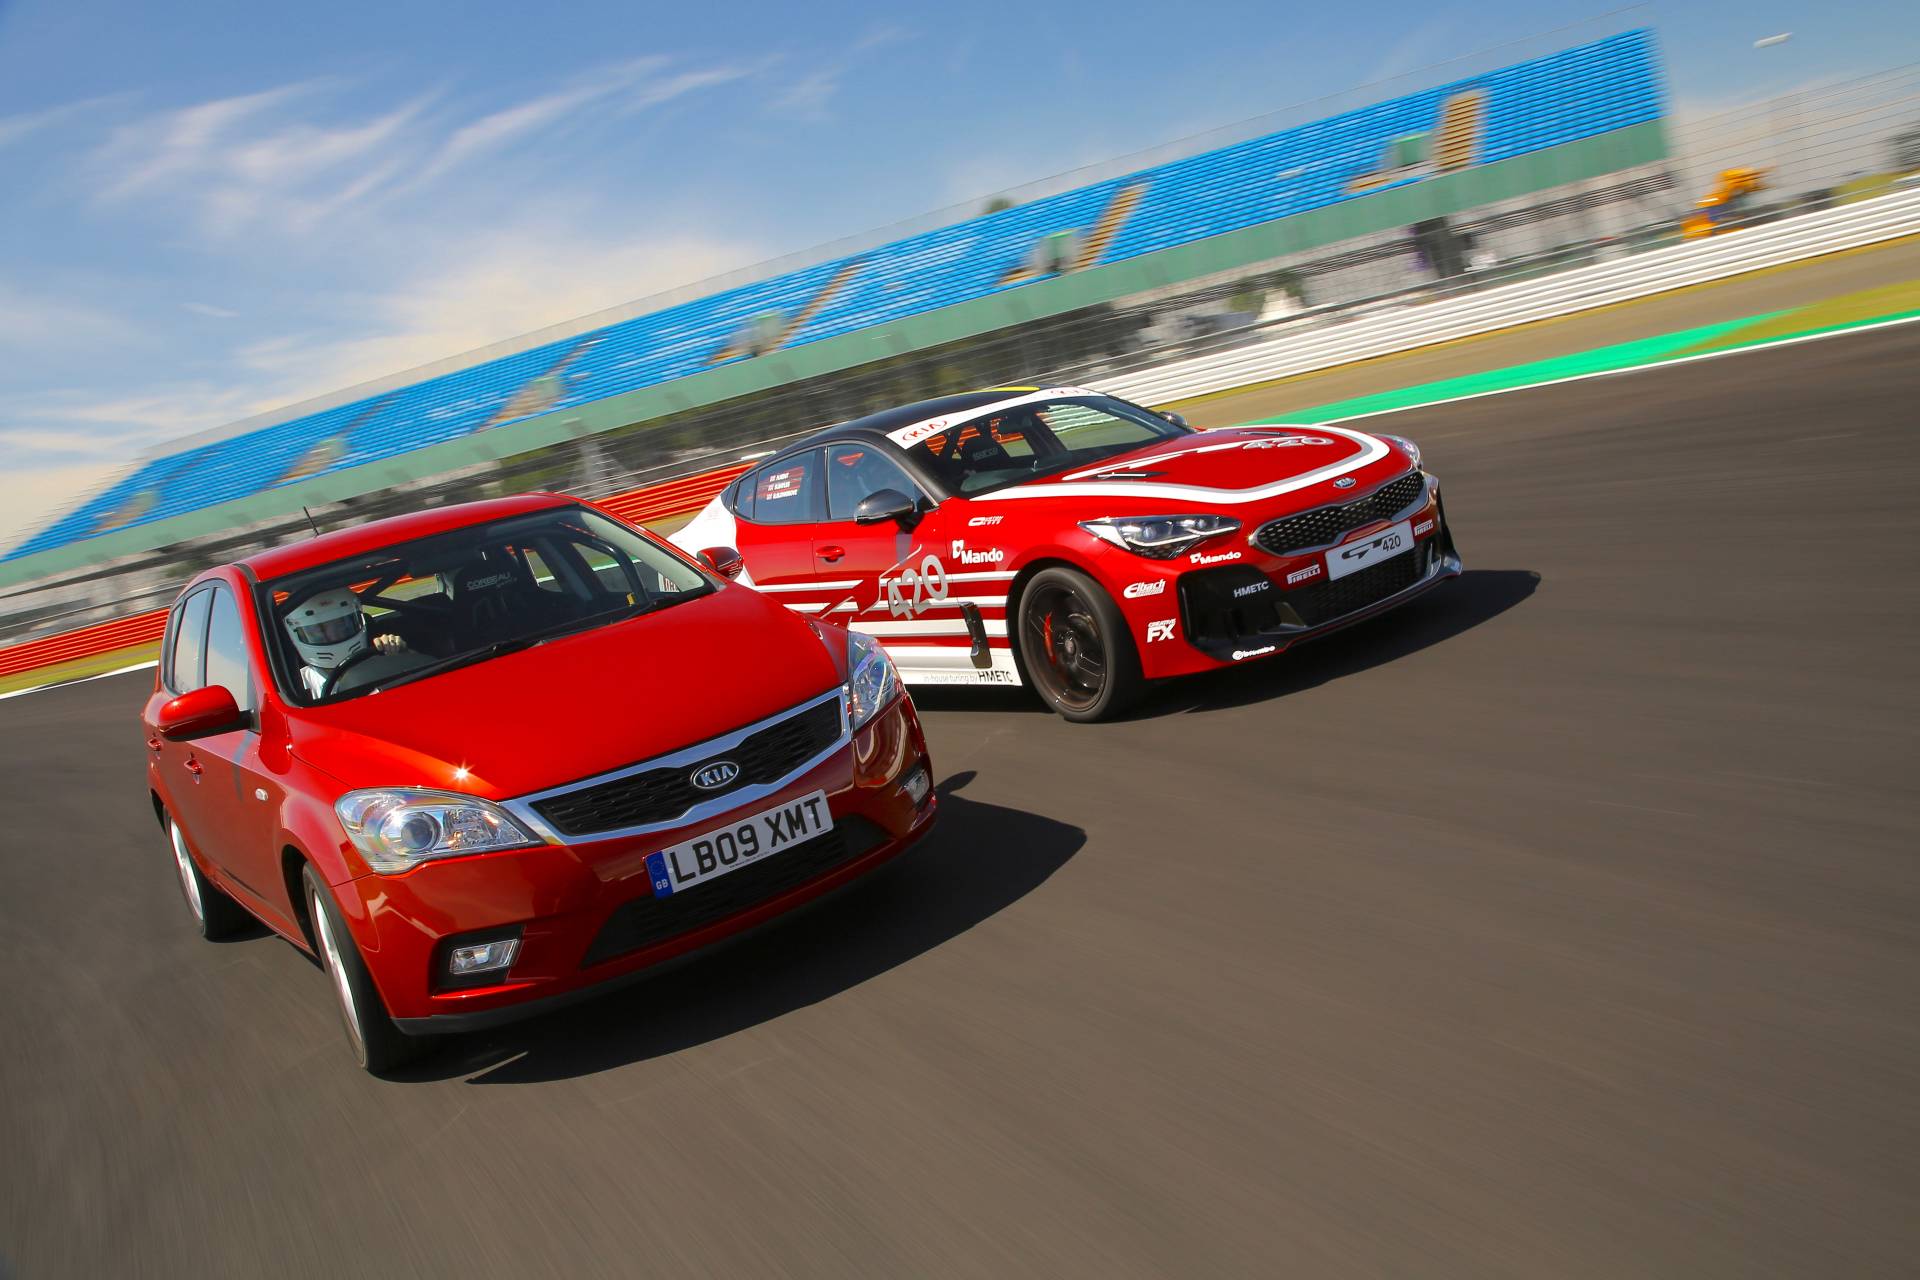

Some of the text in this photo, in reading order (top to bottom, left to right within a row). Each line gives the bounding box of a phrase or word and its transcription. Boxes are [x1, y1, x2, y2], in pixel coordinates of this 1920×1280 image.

[909, 423, 941, 438] KIA
[1242, 436, 1334, 450] 420
[1382, 535, 1402, 552] 420
[961, 547, 1004, 564] Mando
[1199, 551, 1242, 564] Mando
[1286, 564, 1321, 584] PIRELLI
[887, 554, 948, 621] 420
[1233, 581, 1270, 598] HMETC
[1147, 623, 1176, 643] FX
[977, 670, 1013, 683] HMETC
[699, 764, 734, 786] KIA
[670, 797, 822, 884] LB09 XMT
[656, 878, 669, 890] GB
